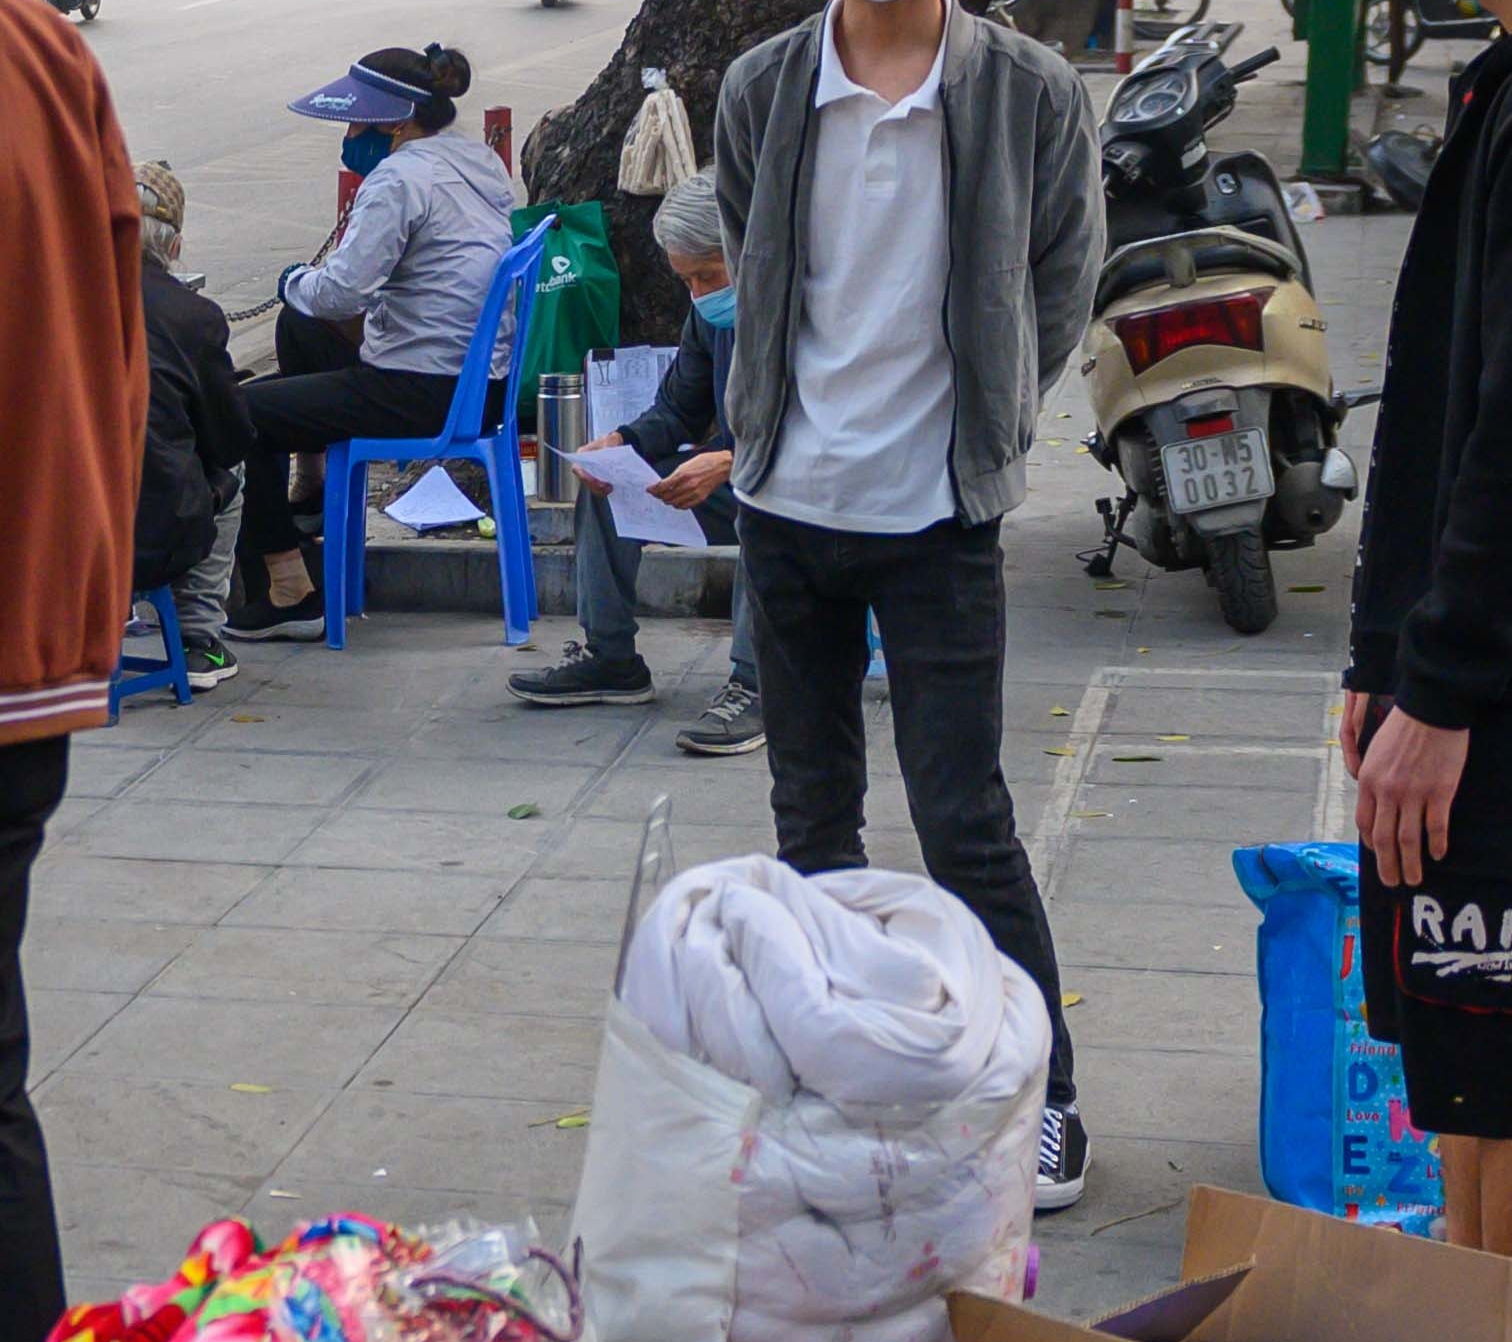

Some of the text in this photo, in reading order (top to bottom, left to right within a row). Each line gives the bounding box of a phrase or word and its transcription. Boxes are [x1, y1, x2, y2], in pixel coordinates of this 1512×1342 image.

[1184, 466, 1260, 505] 0032
[1348, 1062, 1378, 1102] D
[1346, 1109, 1382, 1124] Love
[1342, 1134, 1372, 1176] E
